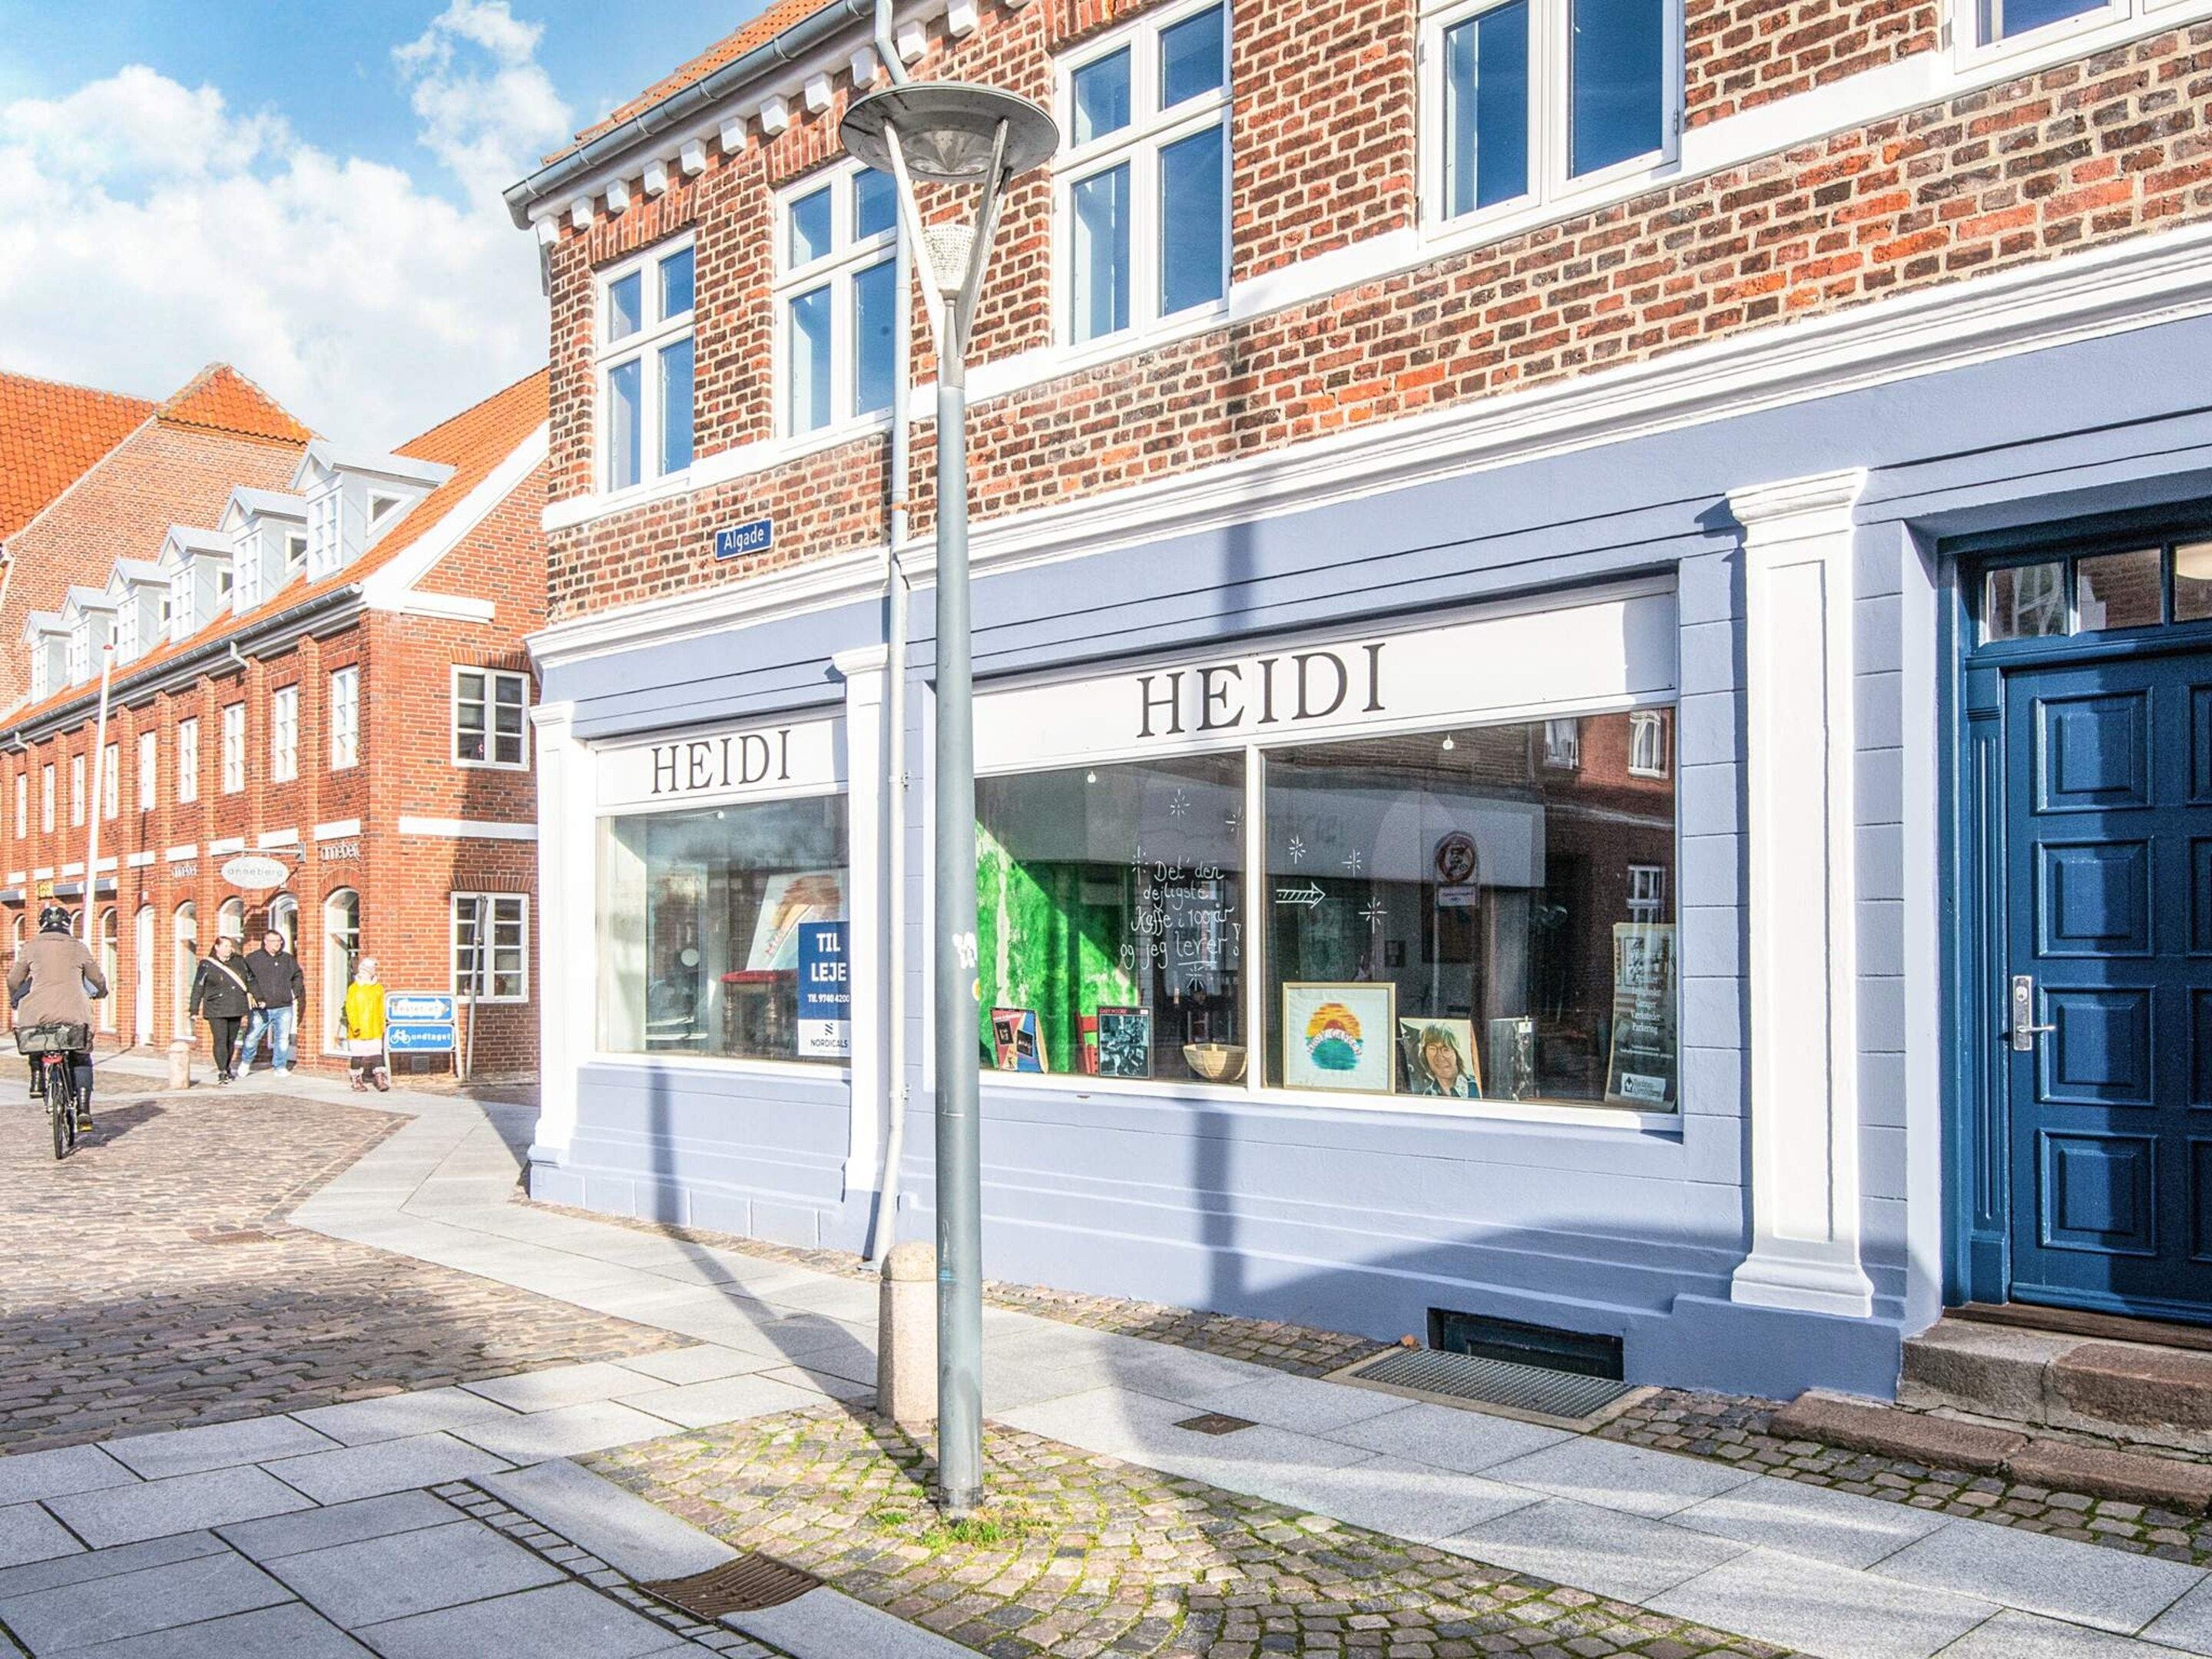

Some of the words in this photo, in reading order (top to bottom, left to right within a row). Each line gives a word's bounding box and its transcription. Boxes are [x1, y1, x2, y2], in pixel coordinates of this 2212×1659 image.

[724, 525, 765, 553] Algade
[1136, 642, 1386, 739] HEIDI
[651, 729, 791, 795] HEIDI
[1194, 861, 1225, 879] den
[1143, 882, 1210, 910] dejligste
[816, 932, 841, 953] TIL
[1120, 943, 1136, 970] og
[1141, 938, 1168, 970] jeg
[810, 962, 847, 982] LEJE
[411, 1032, 452, 1041] undtaget
[810, 1039, 848, 1048] NORDICALS
